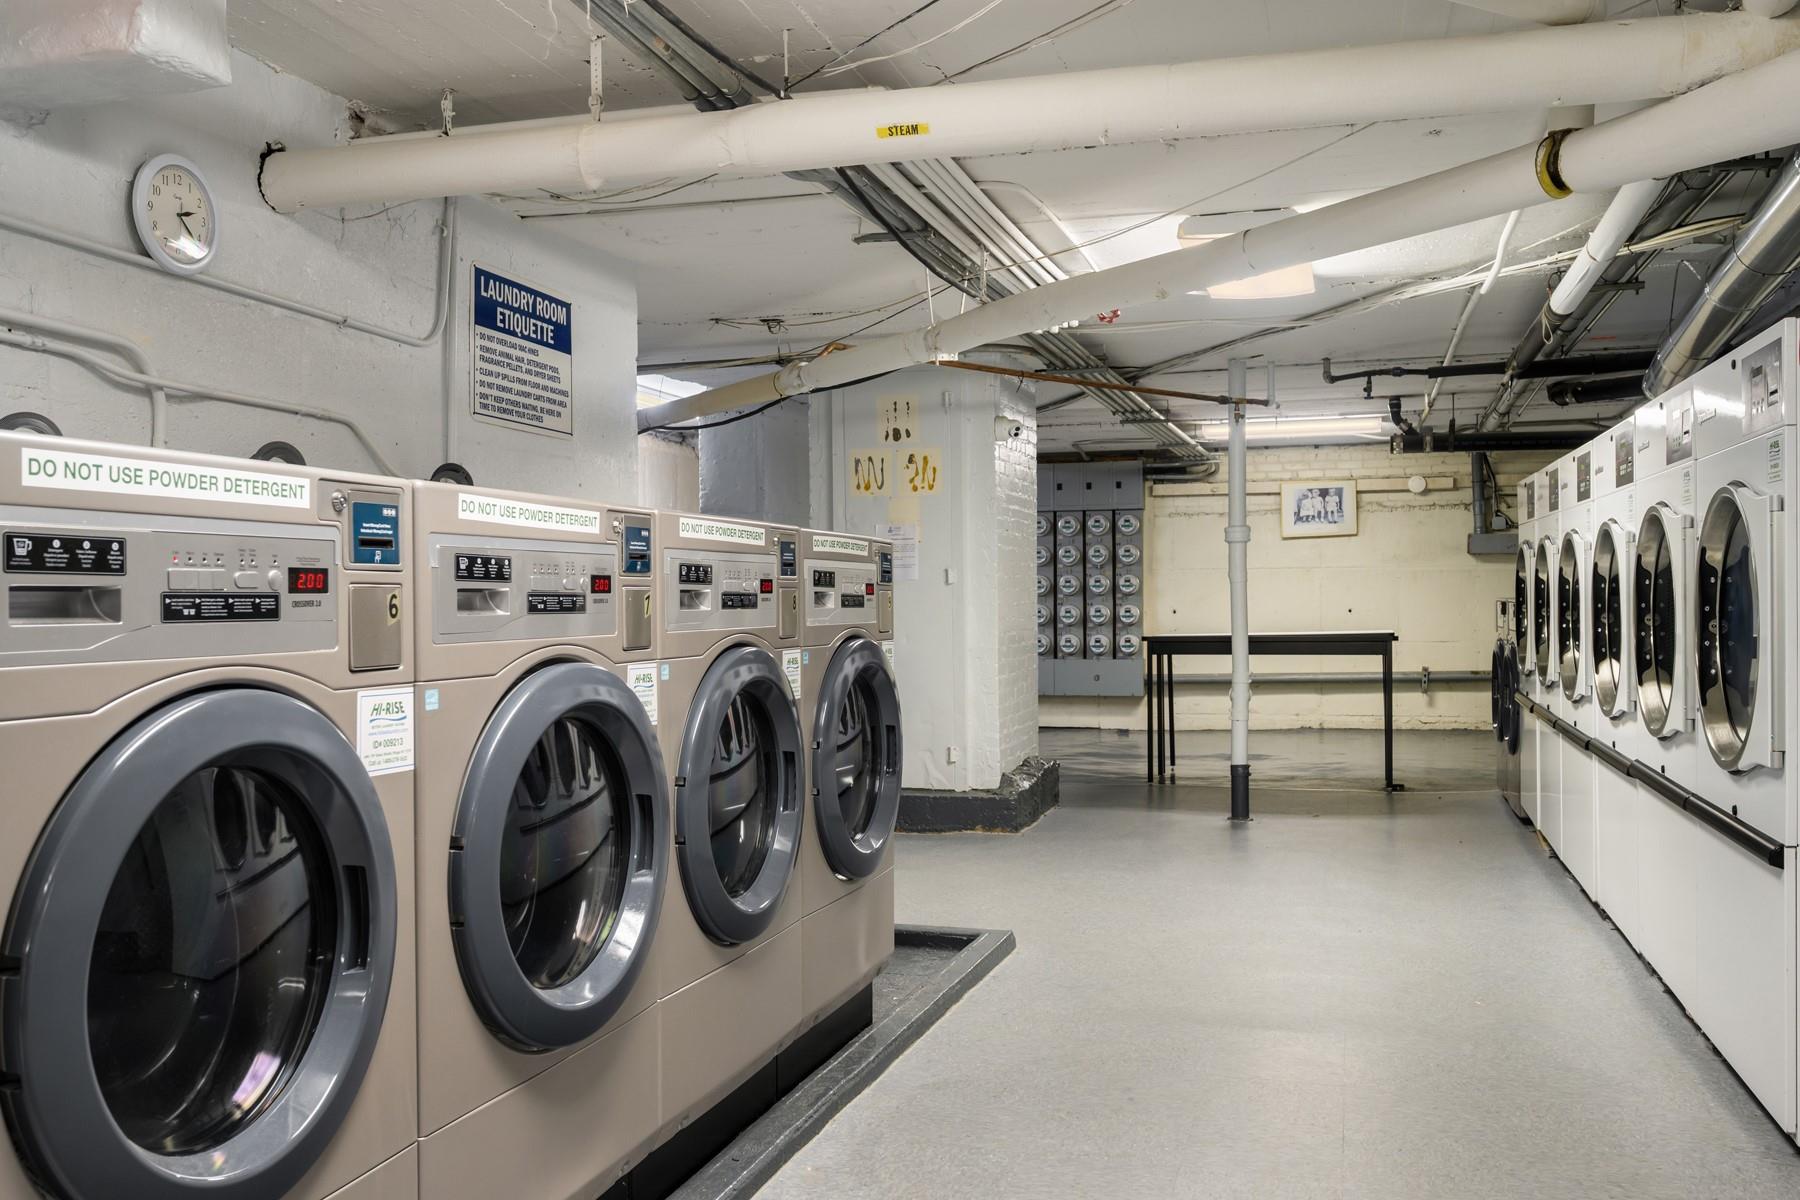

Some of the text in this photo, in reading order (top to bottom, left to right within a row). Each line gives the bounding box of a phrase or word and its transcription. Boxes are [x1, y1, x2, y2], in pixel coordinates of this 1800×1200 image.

[887, 124, 919, 137] STEAM
[162, 174, 169, 186] 11
[173, 173, 182, 186] 12
[188, 182, 192, 194] 1
[152, 184, 161, 196] 10
[147, 201, 153, 211] 9
[197, 198, 202, 209] 2
[152, 221, 158, 231] 8
[201, 217, 206, 228] 3
[163, 237, 168, 247] 7
[480, 275, 567, 326] LAUNDRY ROOM
[496, 306, 555, 344] ETIQUETTE
[480, 332, 486, 341] DO
[486, 334, 496, 343] NOT
[496, 337, 517, 350] OVERLOAD
[480, 344, 498, 357] REMOVE
[498, 350, 514, 362] ANIMAL
[527, 358, 549, 371] DETERGENT
[480, 354, 505, 369] FRAGRANCE
[525, 367, 533, 377] AND
[534, 370, 546, 380] DRYER
[547, 373, 560, 384] SHEETS
[479, 367, 569, 398] CLEAN UP SPILLS FROM FLOOR AND MACHINES
[480, 379, 486, 388] DO
[486, 381, 495, 390] NOT
[496, 383, 513, 395] REMOVE
[513, 388, 532, 399] LAUNDRY
[533, 393, 545, 403] CARTS
[546, 396, 556, 405] FROM
[479, 401, 543, 423] TIME TO REMOVE YOUR CLOTHES
[494, 395, 504, 404] KEEP
[505, 398, 521, 409] OTHERS
[540, 406, 546, 414] BE
[546, 408, 555, 418] HERE
[28, 458, 305, 500] DO NOT USE POWDER DETERGENT
[461, 499, 597, 527] DO NOT USE POWDER DETERGENT
[681, 522, 764, 541] DO NOT USE POWDER DETERGENT
[388, 594, 398, 619] 6
[645, 595, 650, 616] 7
[792, 594, 797, 610] 8
[370, 701, 405, 717] HI-RISE
